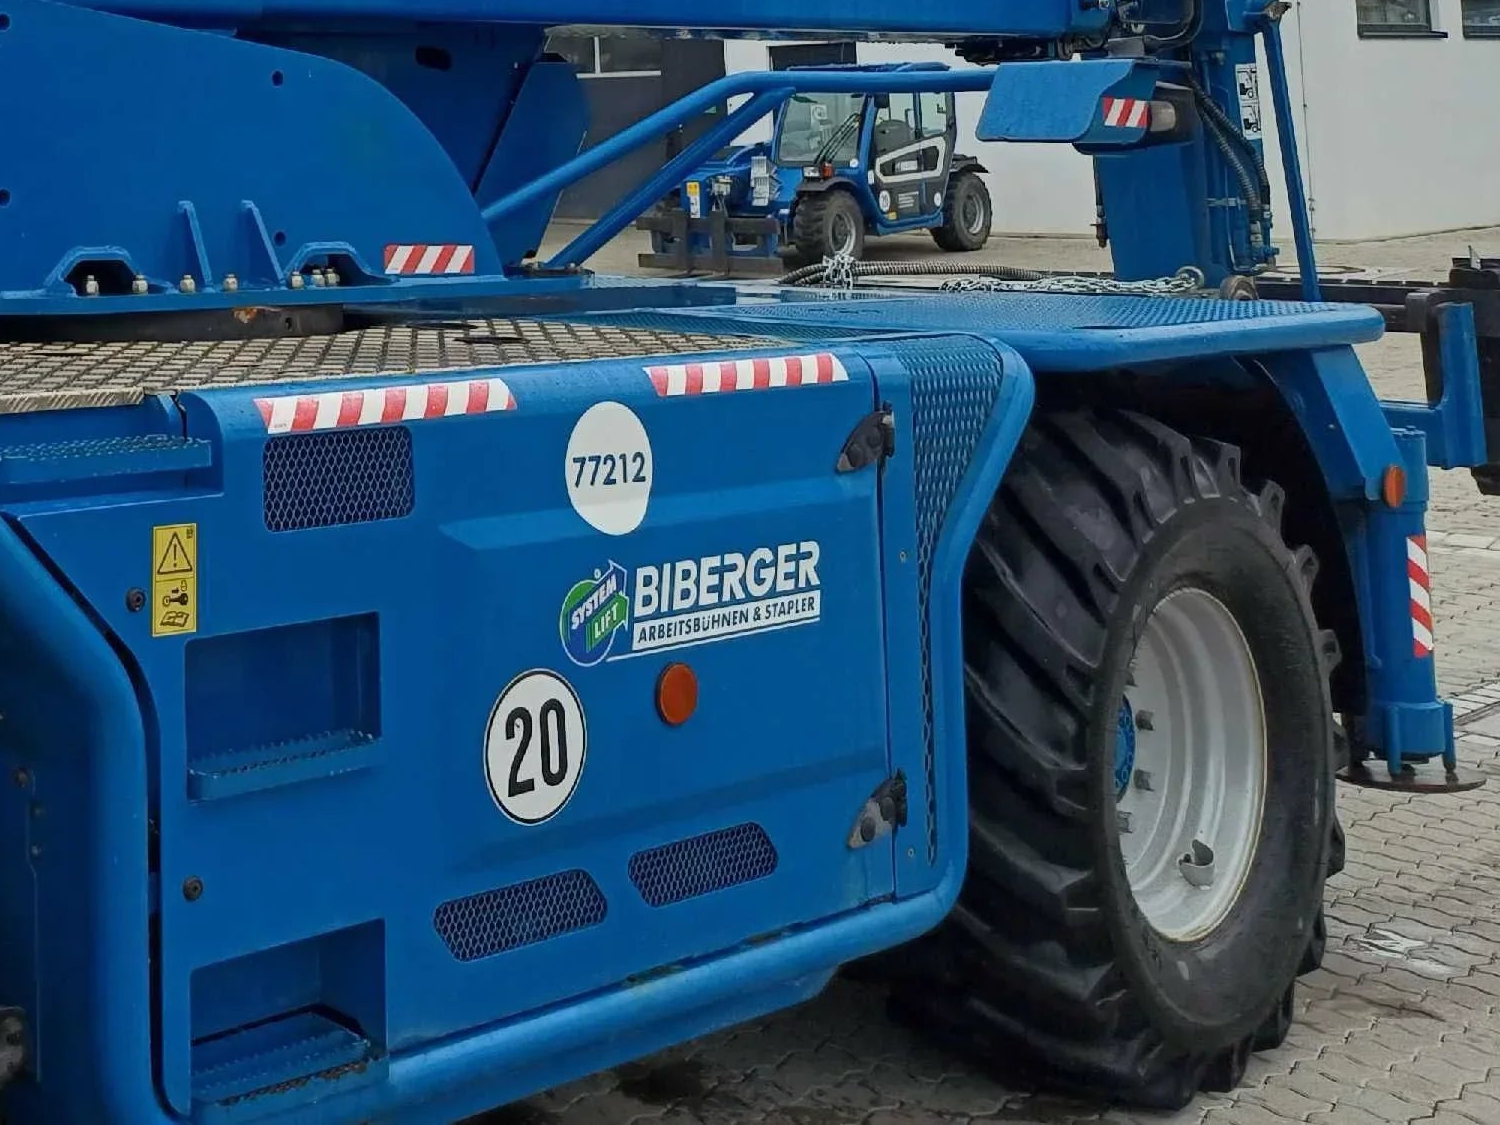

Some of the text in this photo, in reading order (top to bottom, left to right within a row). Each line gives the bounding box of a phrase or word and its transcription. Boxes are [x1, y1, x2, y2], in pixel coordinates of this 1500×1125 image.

[572, 451, 647, 489] 77212
[571, 574, 617, 629] SYSTEM
[634, 540, 821, 618] BIBERGER
[594, 602, 618, 639] LIFT
[637, 596, 815, 644] ARBEITSBÜHNEN & STAPLER
[505, 698, 569, 798] 20
